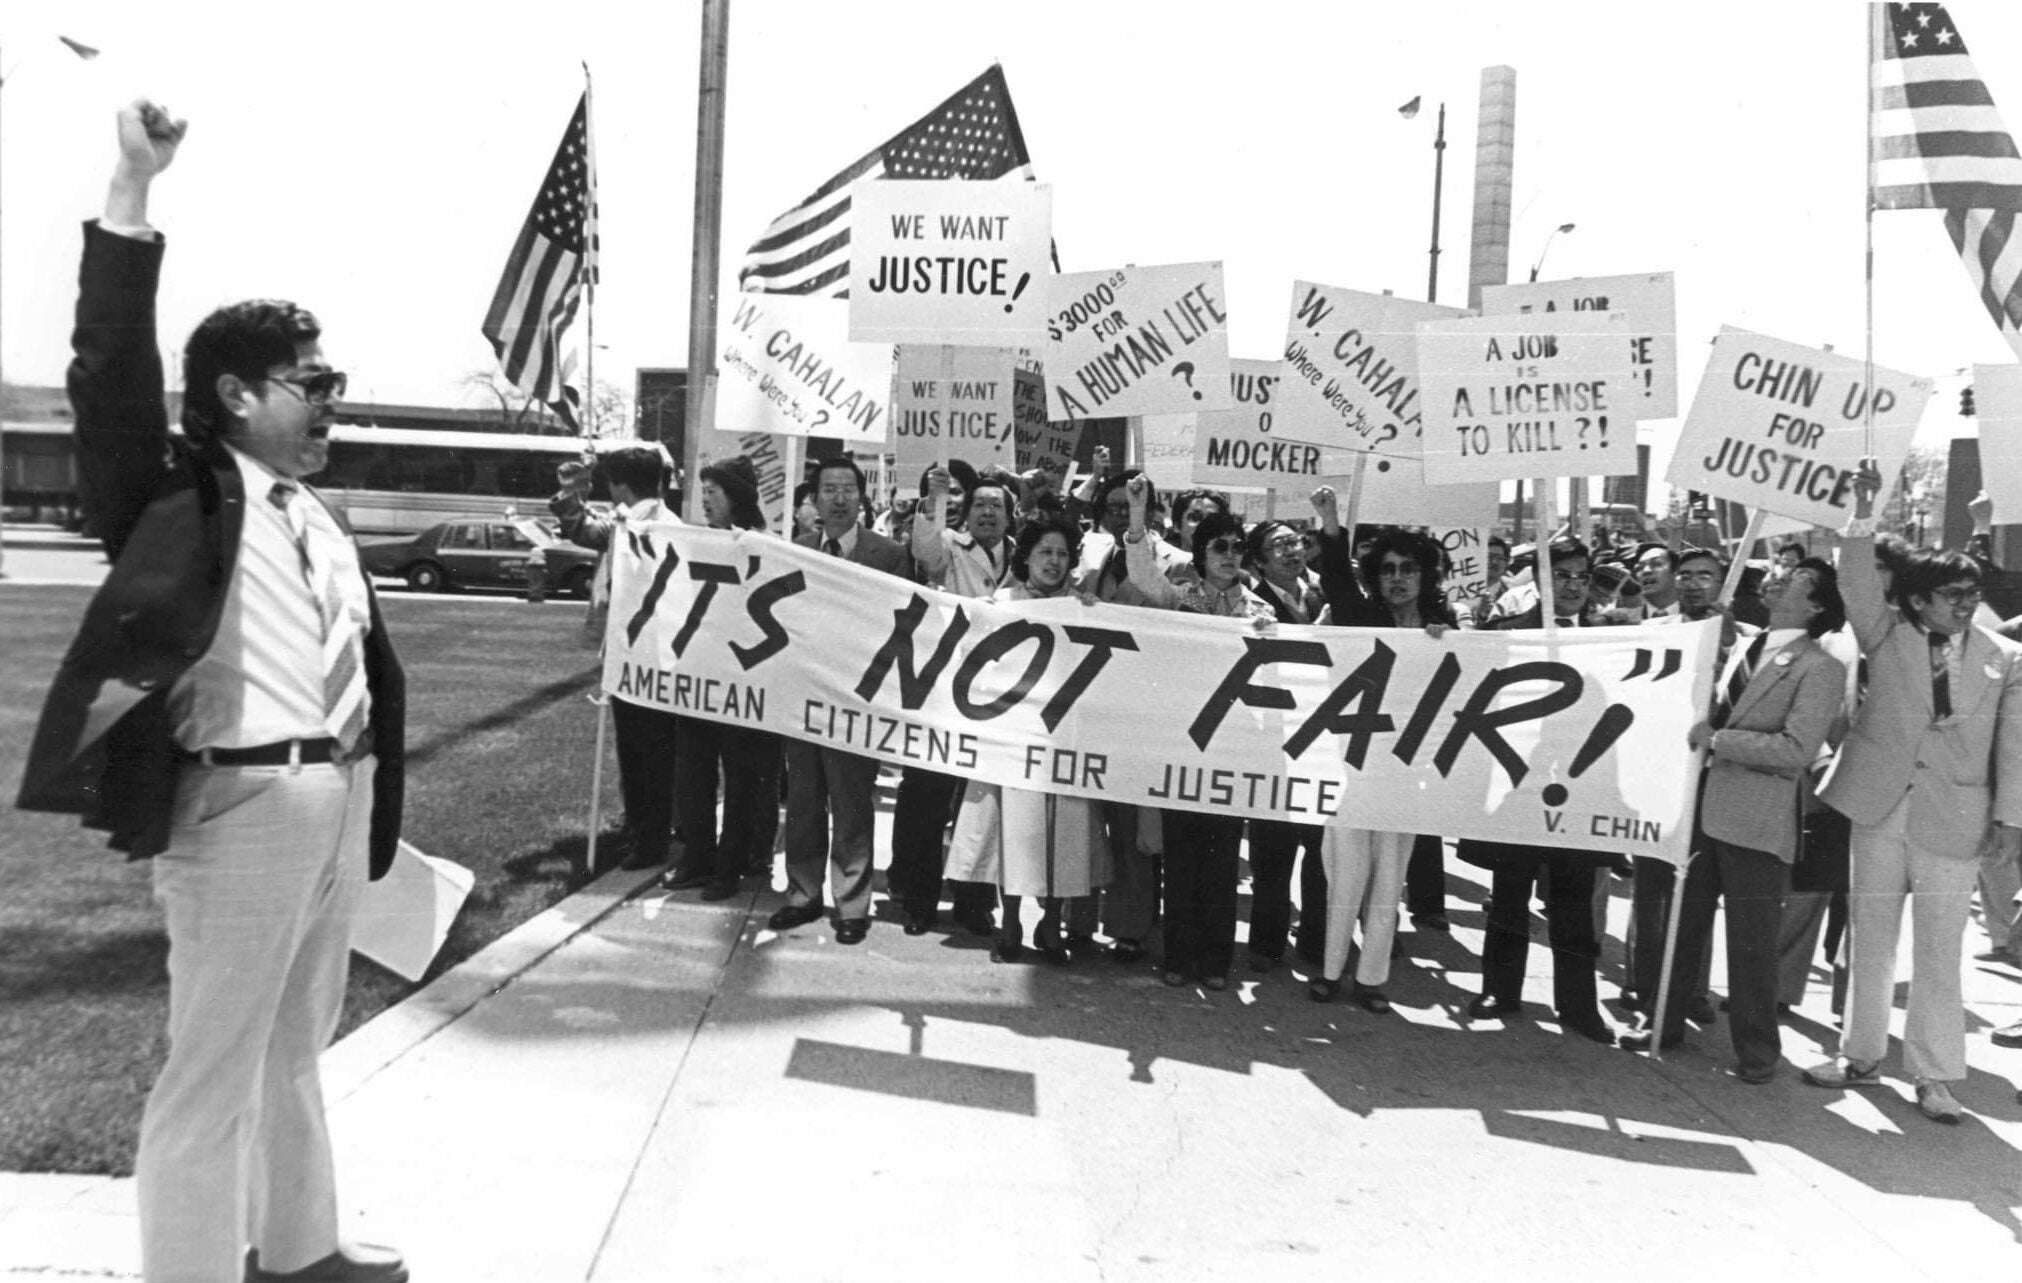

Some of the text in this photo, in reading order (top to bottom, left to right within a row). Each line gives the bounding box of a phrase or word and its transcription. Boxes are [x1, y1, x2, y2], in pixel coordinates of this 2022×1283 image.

[891, 213, 1010, 242] WE WANT
[868, 255, 1031, 314] JUSTICE!
[1092, 309, 1129, 344] FOR
[731, 297, 884, 433] W. CAHALAN
[1056, 282, 1227, 421] A HUMAN LIFE
[1296, 286, 1424, 438] W. CAHALA
[1485, 334, 1560, 363] A JOB
[911, 379, 1000, 401] WE WANT
[1171, 360, 1203, 401] ?
[1230, 372, 1281, 405] US
[1284, 339, 1325, 387] Where
[1322, 378, 1355, 418] Were
[1515, 365, 1539, 378] IS
[1733, 351, 1897, 422] CHIN UP
[1452, 380, 1609, 419] A LICENSE
[1455, 423, 1491, 457] TO
[1506, 421, 1562, 454] KILL
[1766, 412, 1825, 450] FOR
[1205, 437, 1321, 476] MOCKER
[1702, 437, 1856, 510] JUSTICE
[1441, 527, 1481, 552] ON
[1448, 556, 1481, 580] HE
[854, 592, 1141, 734] NOT
[617, 661, 1341, 817] AMERICAN CITIZENS FOR JUSTICE
[1542, 810, 1662, 843] V. CHIN
